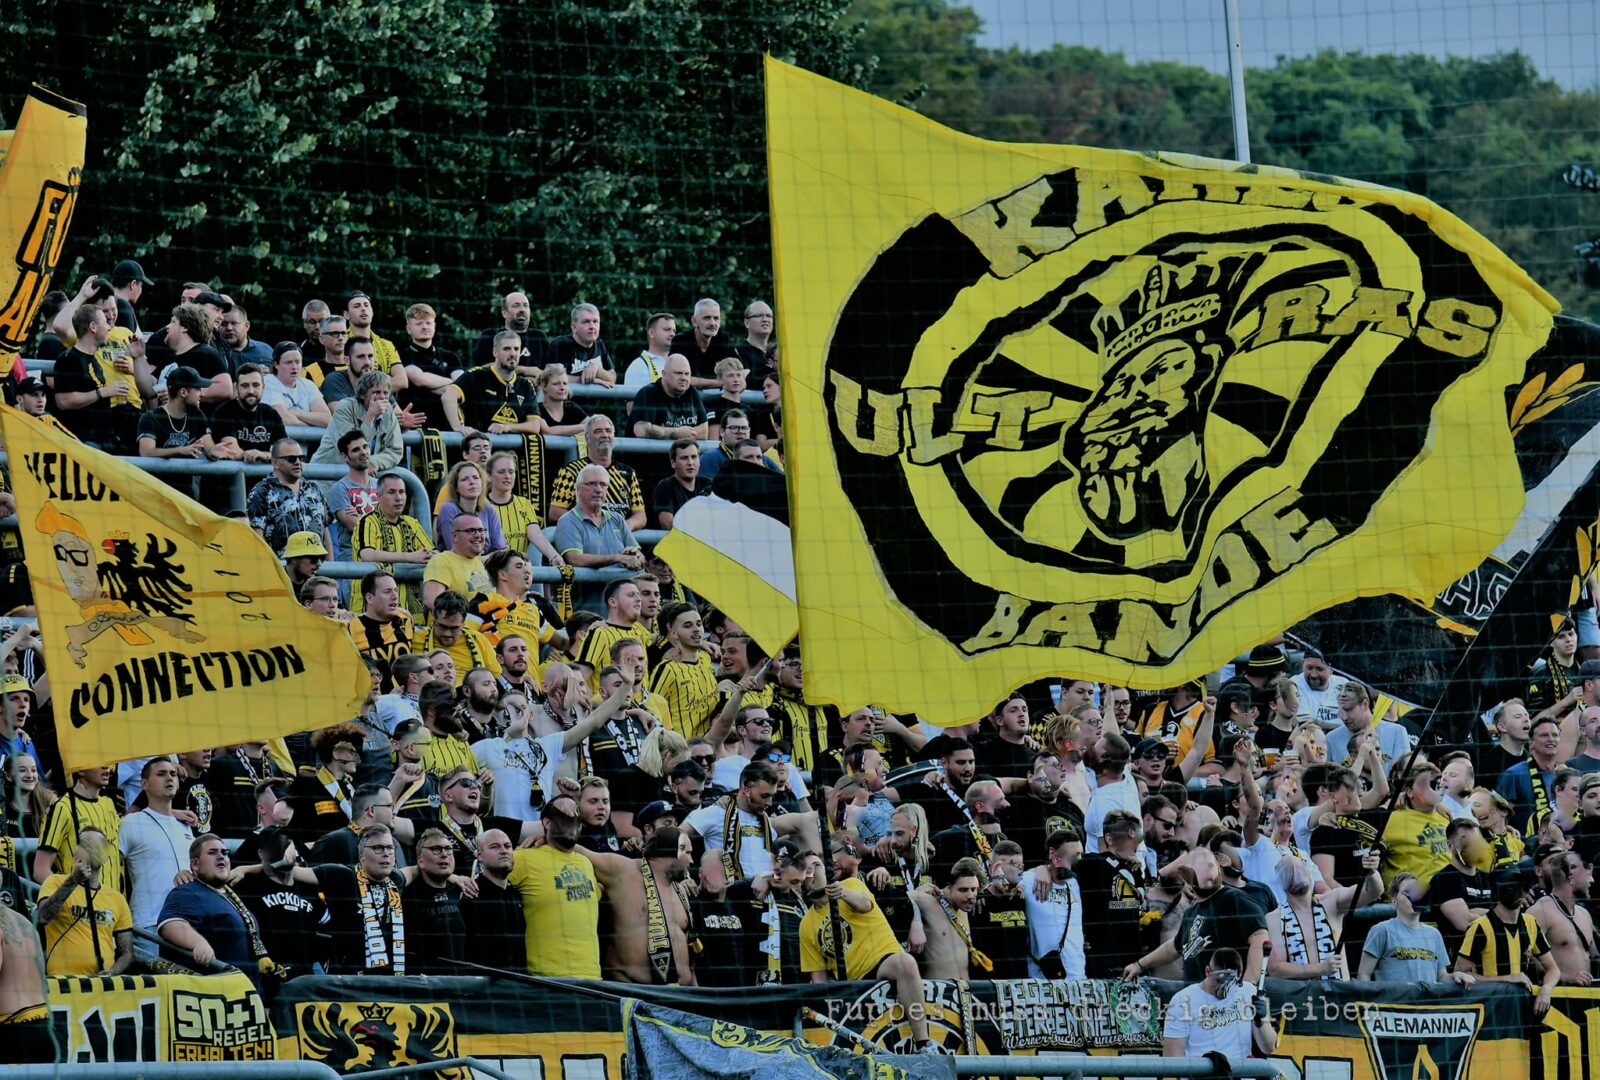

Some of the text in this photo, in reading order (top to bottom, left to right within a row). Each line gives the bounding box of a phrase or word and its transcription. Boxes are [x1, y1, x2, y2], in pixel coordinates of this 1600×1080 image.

[24, 451, 120, 501] YELLO
[529, 434, 541, 511] ALEMANNIA
[70, 643, 305, 729] CONNECTION
[262, 891, 314, 913] KICKOFF
[212, 1024, 272, 1047] REGEL
[1372, 1017, 1472, 1035] ALEMANNIA
